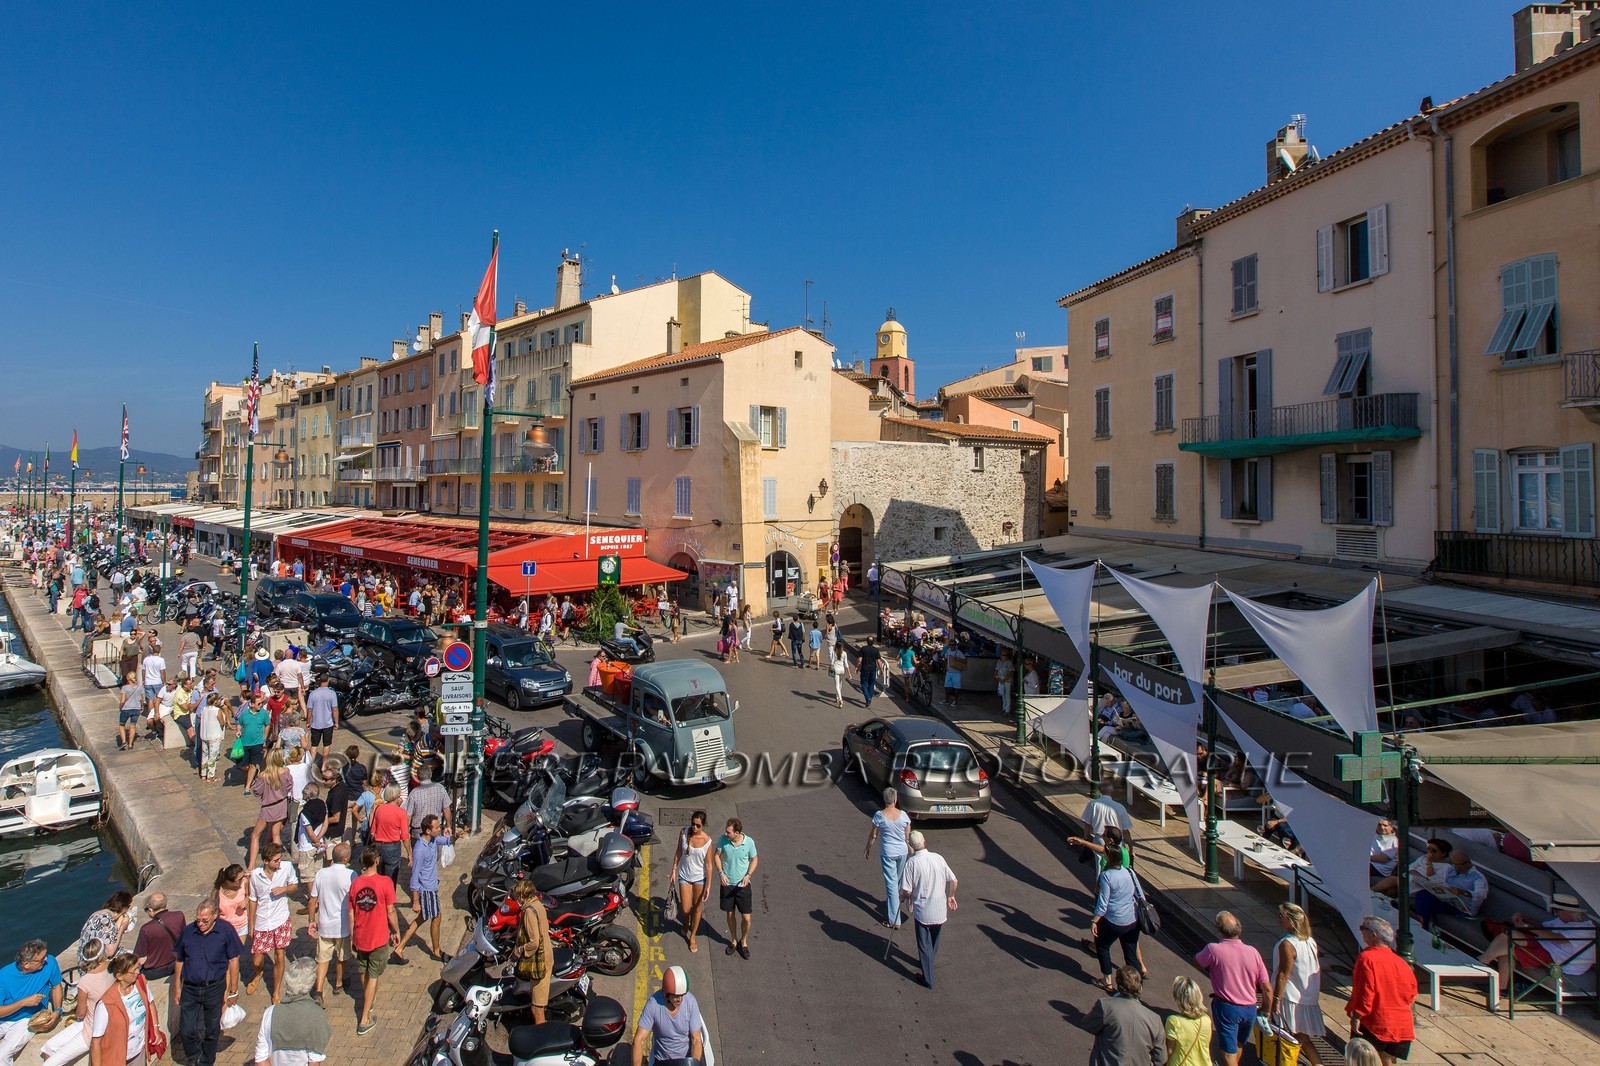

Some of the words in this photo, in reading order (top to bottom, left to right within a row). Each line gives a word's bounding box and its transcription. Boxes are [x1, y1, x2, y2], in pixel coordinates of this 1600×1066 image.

[590, 535, 642, 544] SENEQUIER
[341, 546, 364, 556] SENEQUIER
[407, 556, 439, 569] SENEQUIER
[1114, 662, 1133, 683] bar
[1136, 672, 1151, 691] du
[1155, 682, 1182, 704] port
